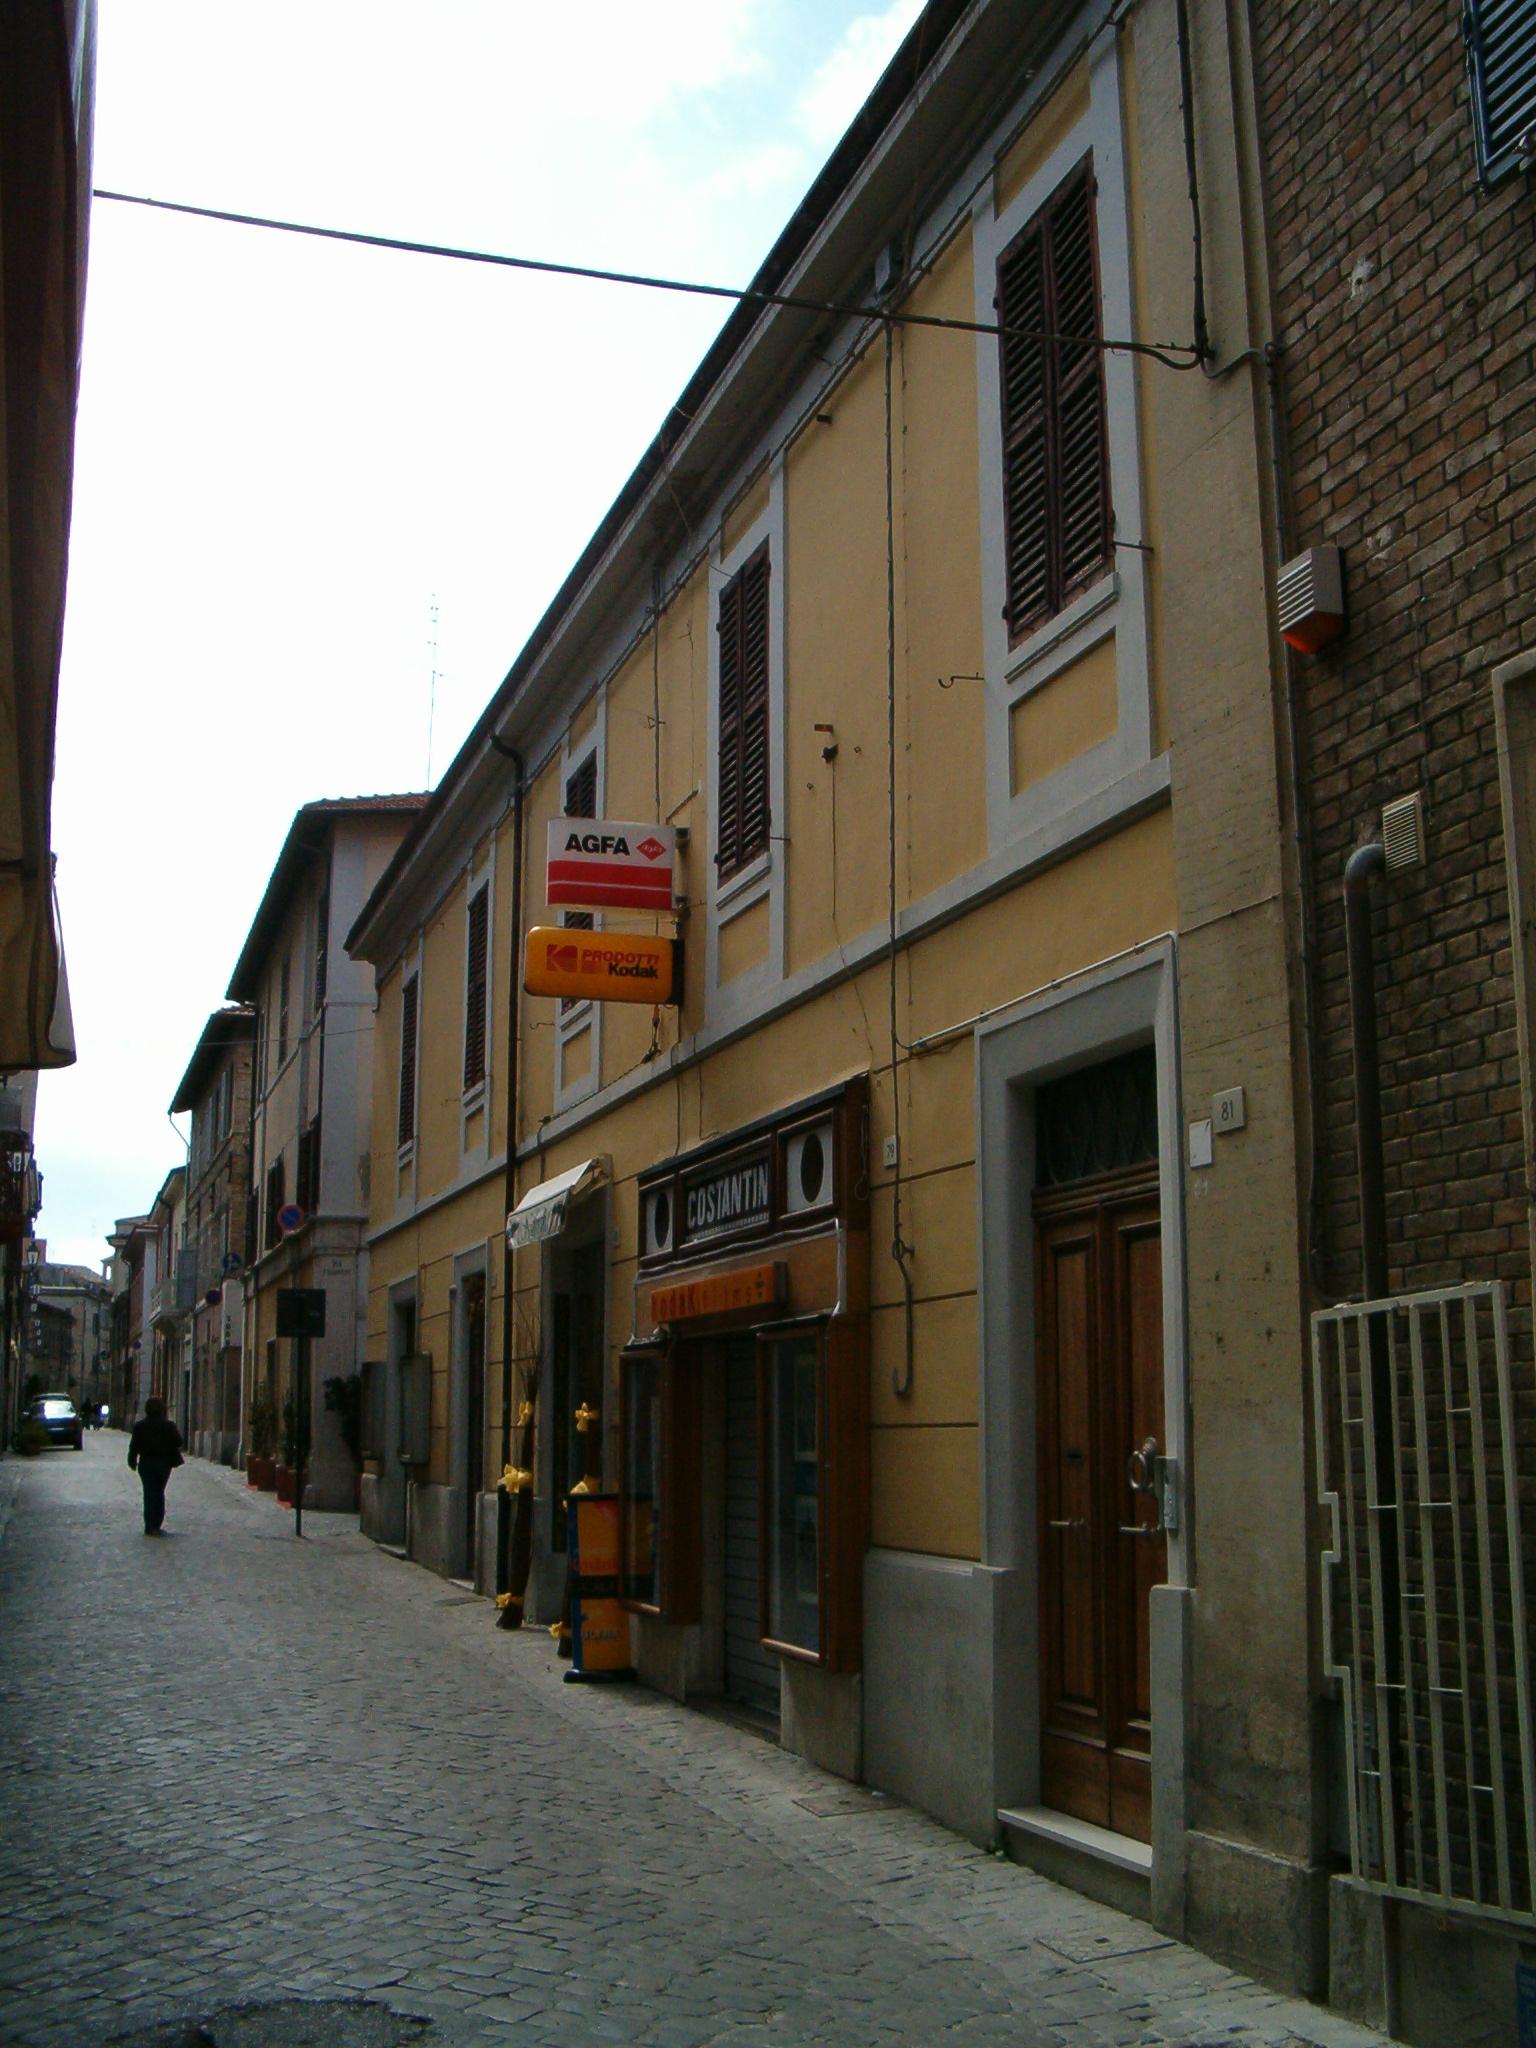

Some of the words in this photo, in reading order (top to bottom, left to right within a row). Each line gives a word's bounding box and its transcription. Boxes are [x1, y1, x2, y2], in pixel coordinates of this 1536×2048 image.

[564, 833, 630, 857] AGFA
[582, 948, 660, 964] PRODOTTI
[608, 961, 659, 979] Kodak
[1221, 1099, 1234, 1121] 81
